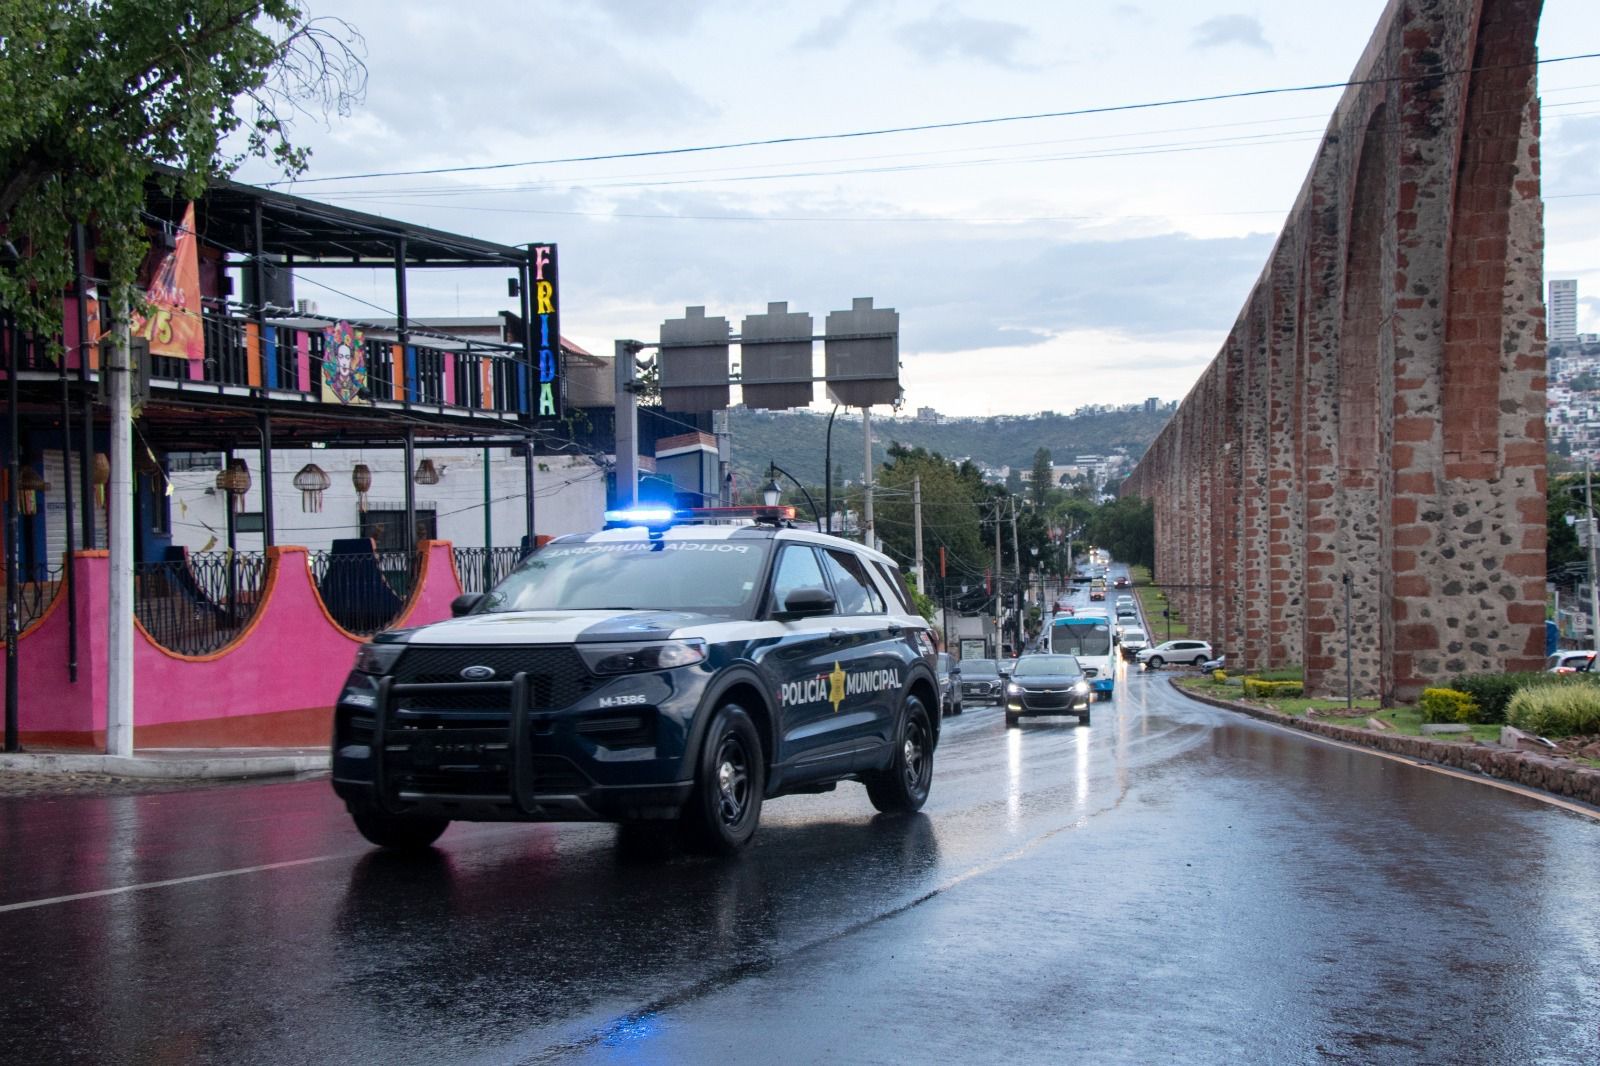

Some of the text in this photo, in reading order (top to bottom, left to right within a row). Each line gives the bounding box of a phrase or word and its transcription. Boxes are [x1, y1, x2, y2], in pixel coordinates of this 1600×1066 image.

[535, 246, 556, 416] FRIDA
[781, 668, 902, 707] POLICÍA MUNICIPAL
